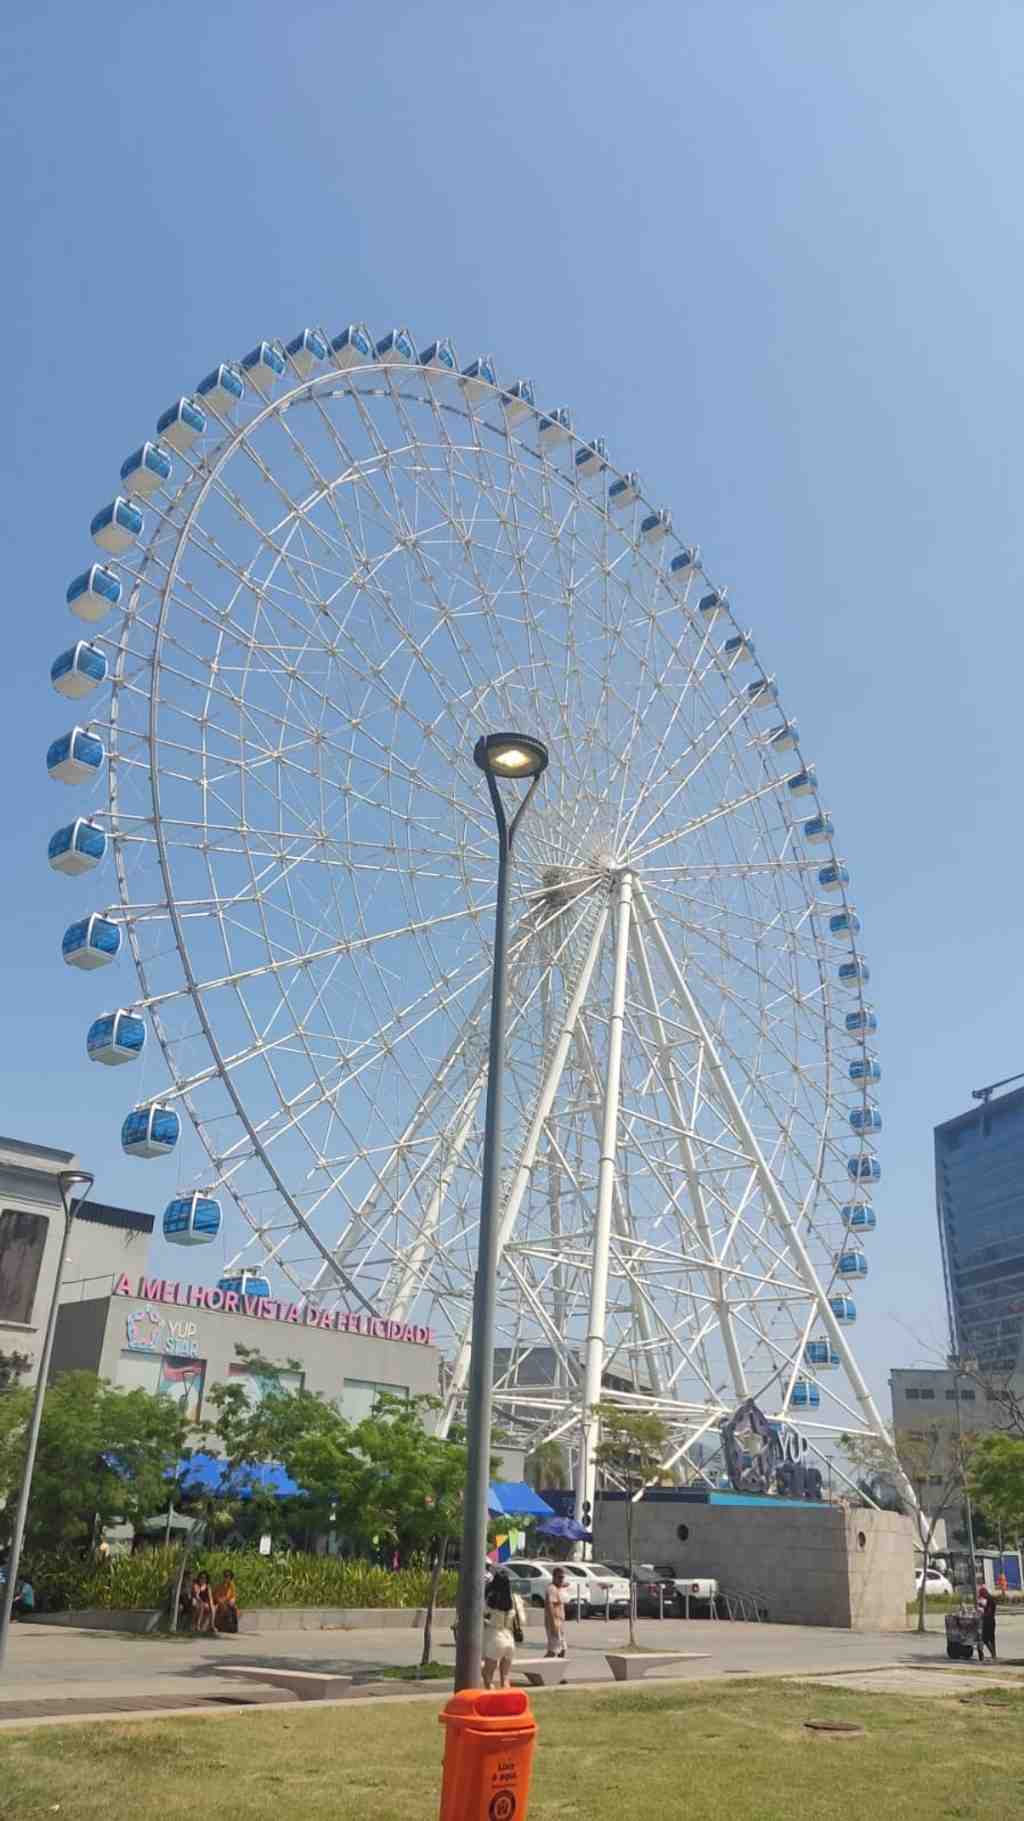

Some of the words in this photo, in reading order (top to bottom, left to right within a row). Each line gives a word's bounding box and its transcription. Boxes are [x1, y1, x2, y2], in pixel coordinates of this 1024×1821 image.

[116, 1271, 132, 1296] A
[142, 1278, 237, 1313] MELHOR
[242, 1295, 299, 1323] VISTA
[306, 1305, 335, 1329] DA
[168, 1320, 197, 1338] YUP
[777, 1424, 808, 1463] YUP
